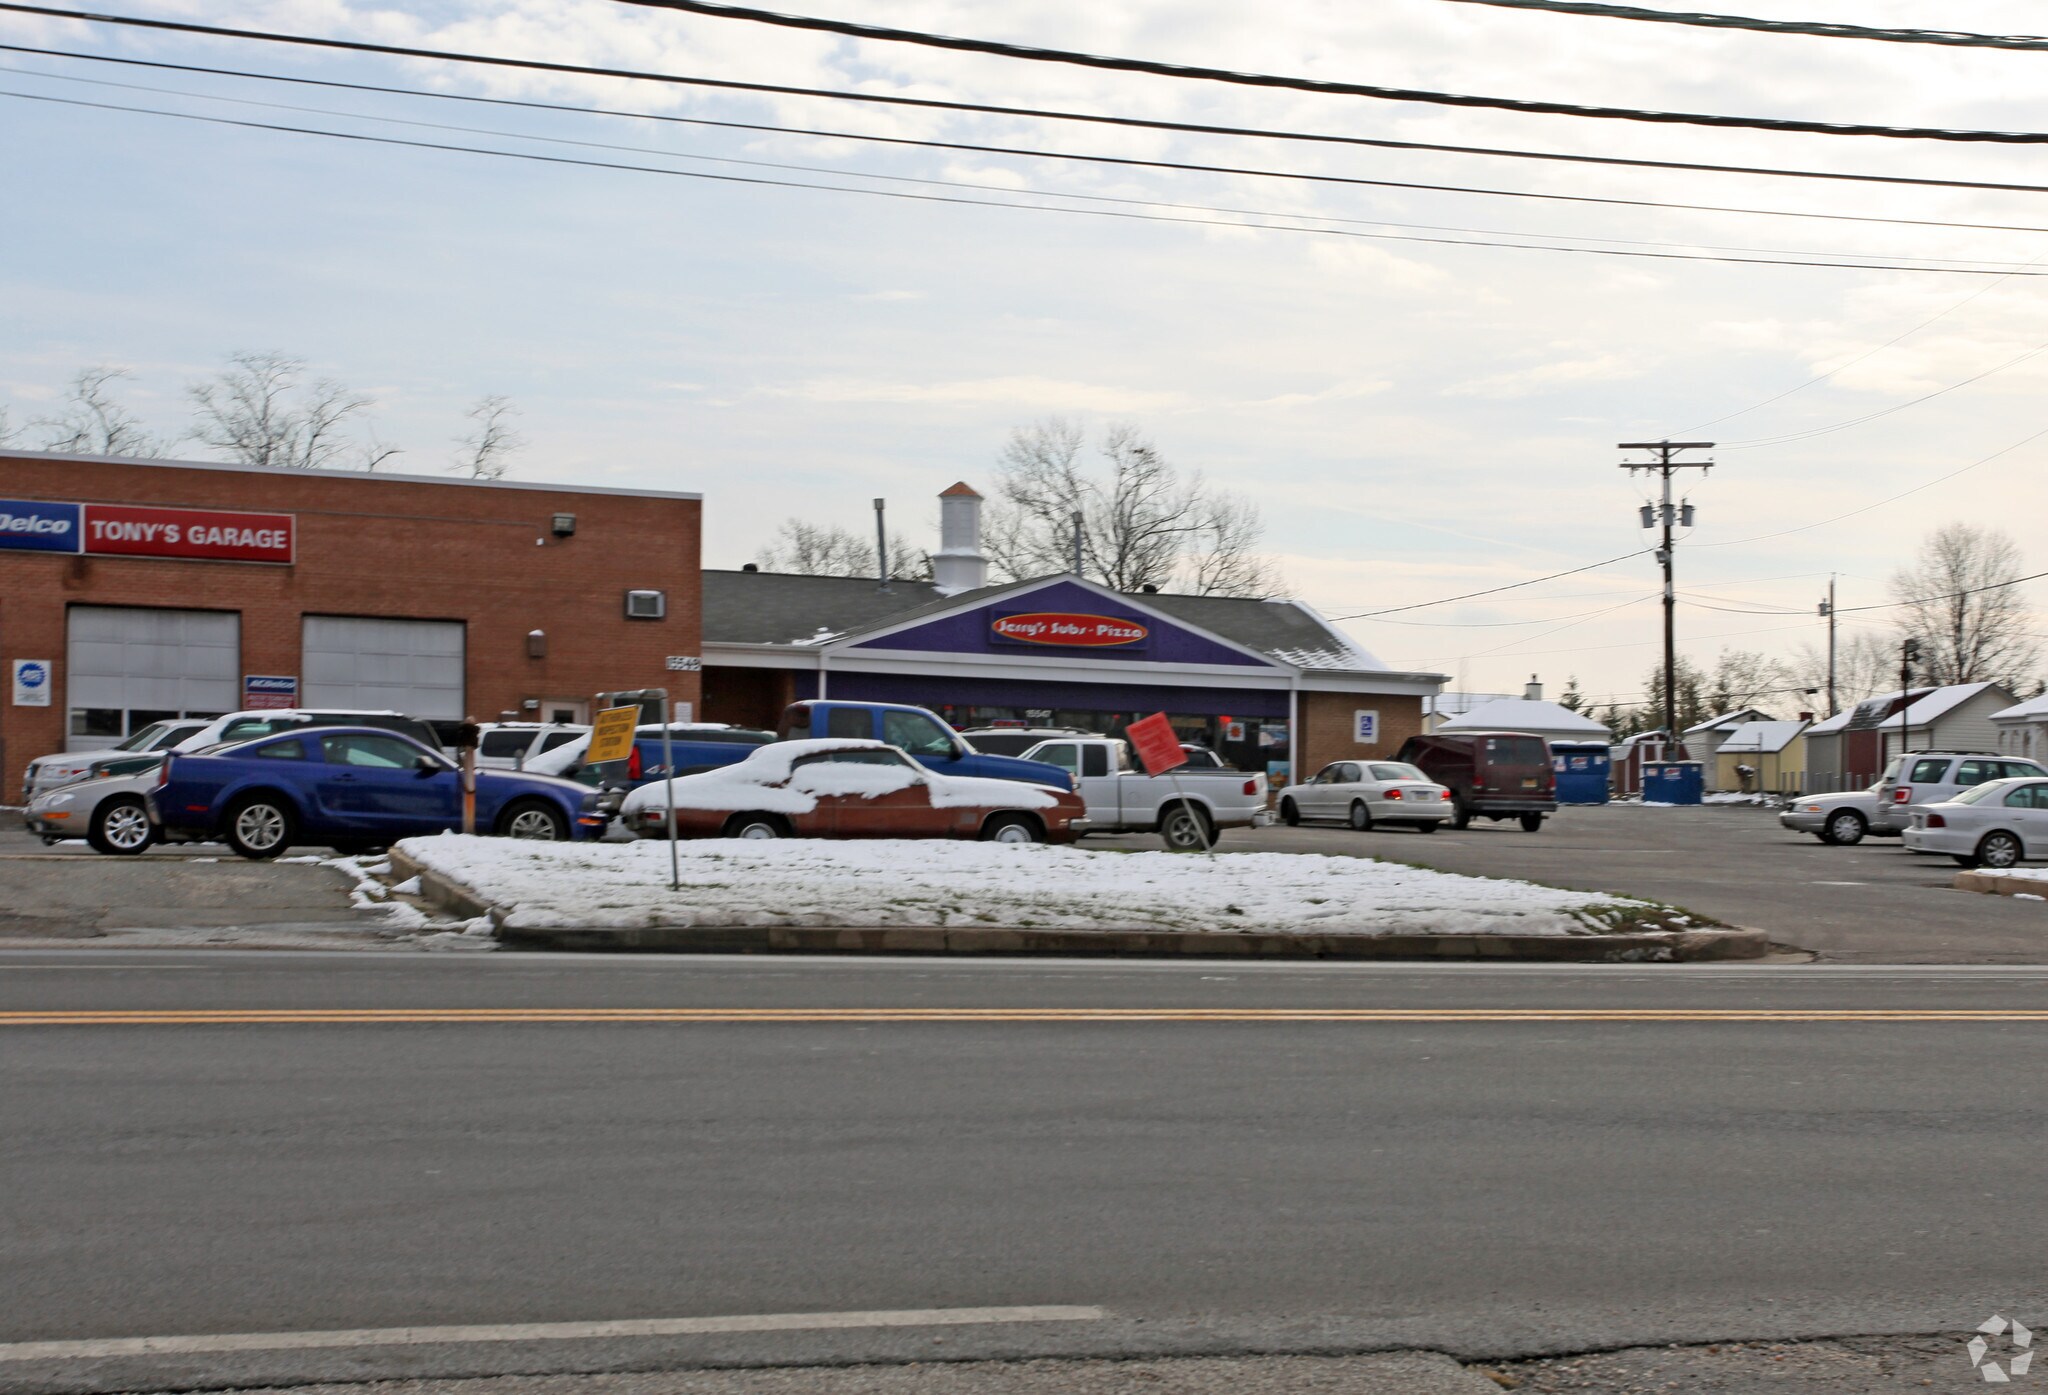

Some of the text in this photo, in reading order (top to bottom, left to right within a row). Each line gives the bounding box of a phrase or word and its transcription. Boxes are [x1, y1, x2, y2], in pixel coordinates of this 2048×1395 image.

[0, 514, 71, 534] Delco
[90, 520, 287, 549] TONY'S GARAGE
[998, 620, 1047, 636] Jerry's
[1050, 622, 1086, 635] Subs
[1096, 624, 1143, 638] Pizza
